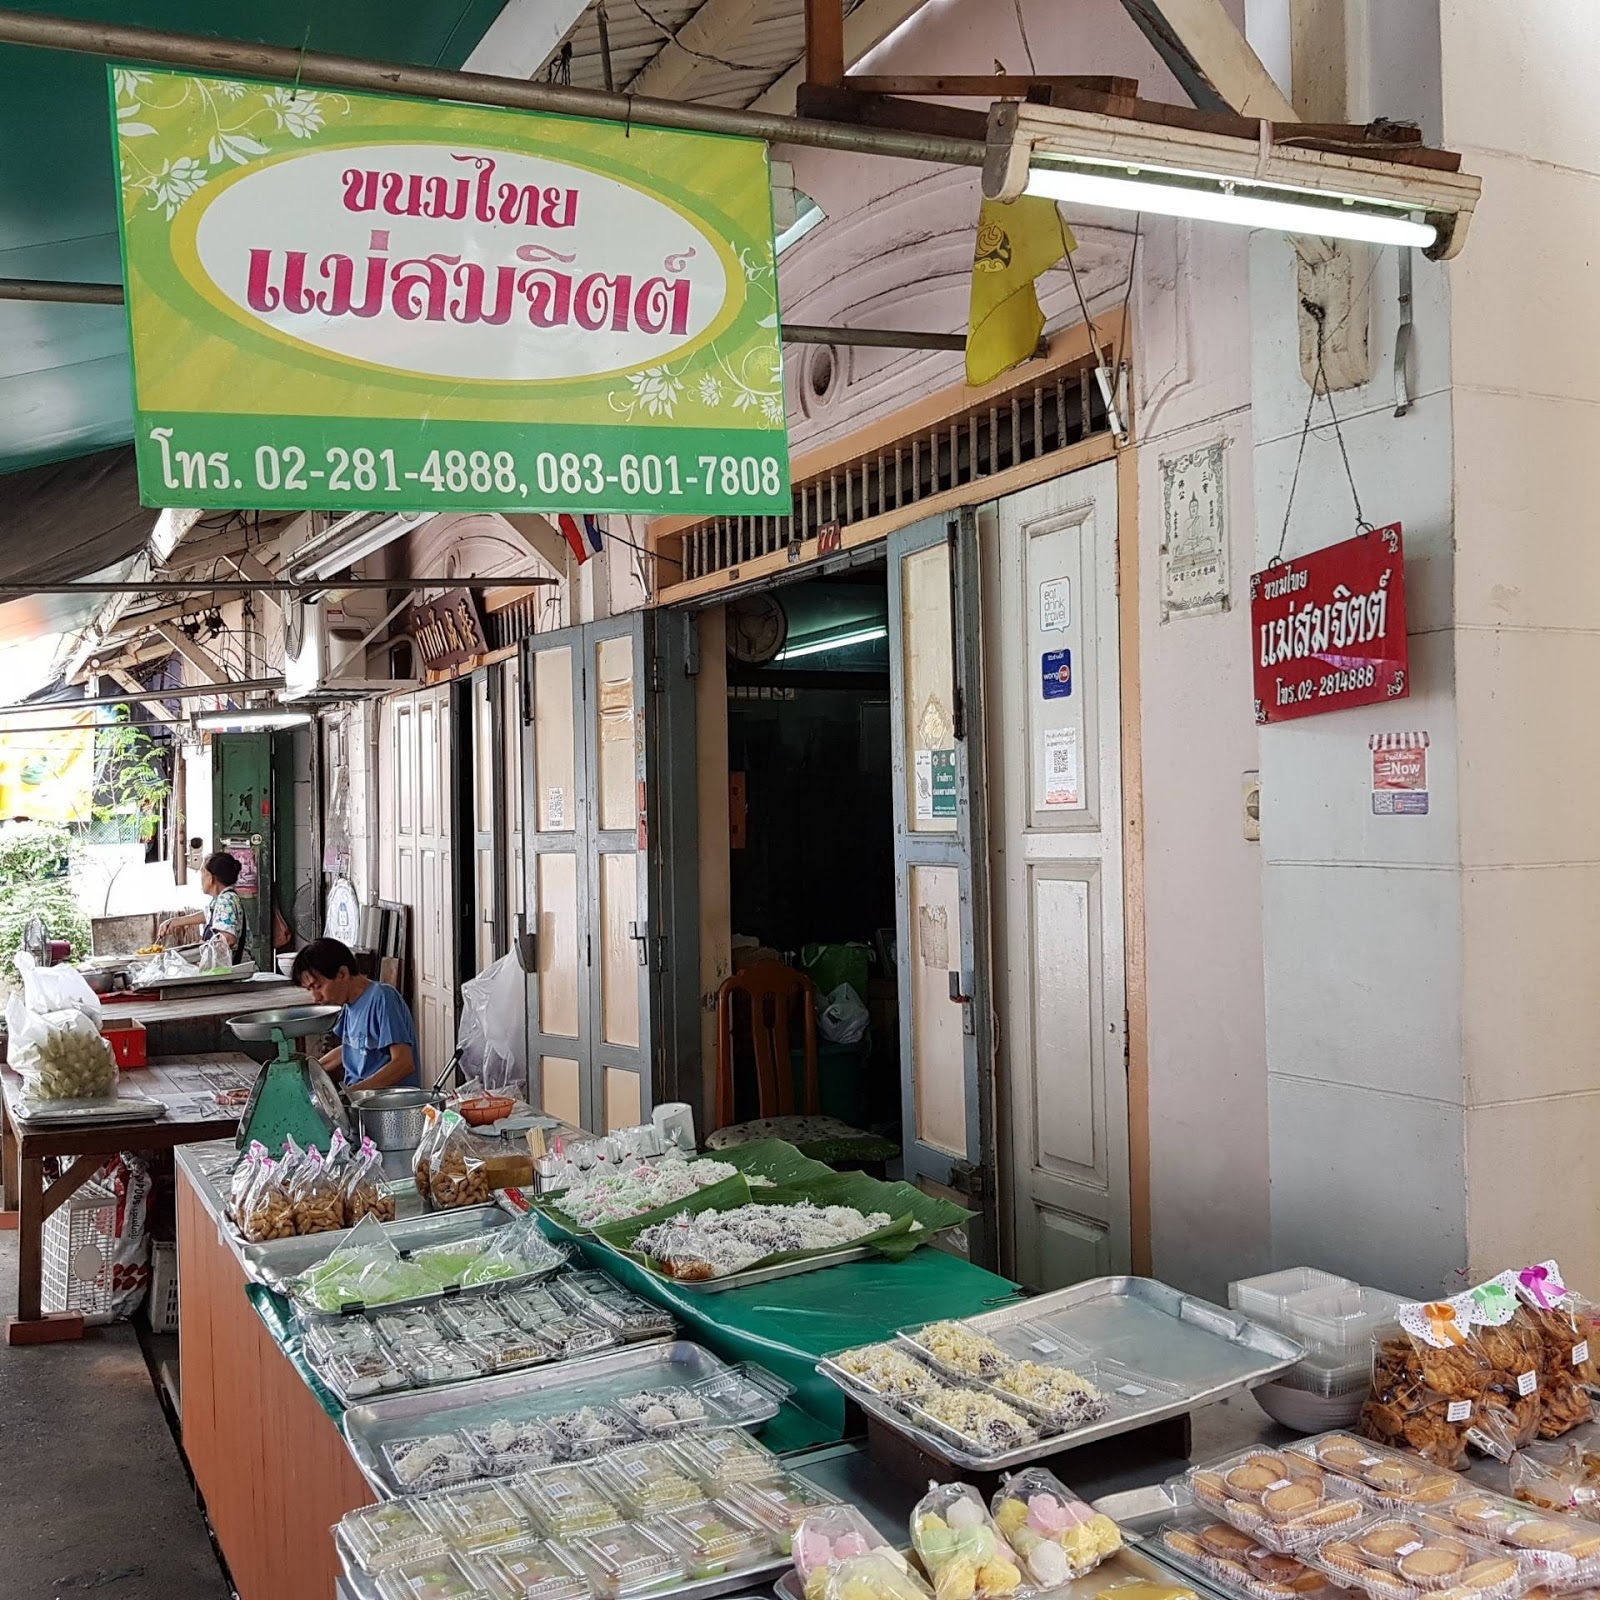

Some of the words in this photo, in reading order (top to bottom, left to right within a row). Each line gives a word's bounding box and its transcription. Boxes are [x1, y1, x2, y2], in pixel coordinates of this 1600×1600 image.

[341, 153, 579, 229] ขนมไทย
[246, 230, 698, 336] แม่สมจิตต์
[150, 428, 243, 491] โทร.
[254, 444, 528, 497] 02-281-4888,
[537, 450, 780, 498] 083-601-7808
[820, 525, 835, 550] 77
[1263, 564, 1309, 601] ขนมไทย
[1260, 568, 1393, 668] แม่สมจิตต์
[1391, 761, 1421, 775] Now
